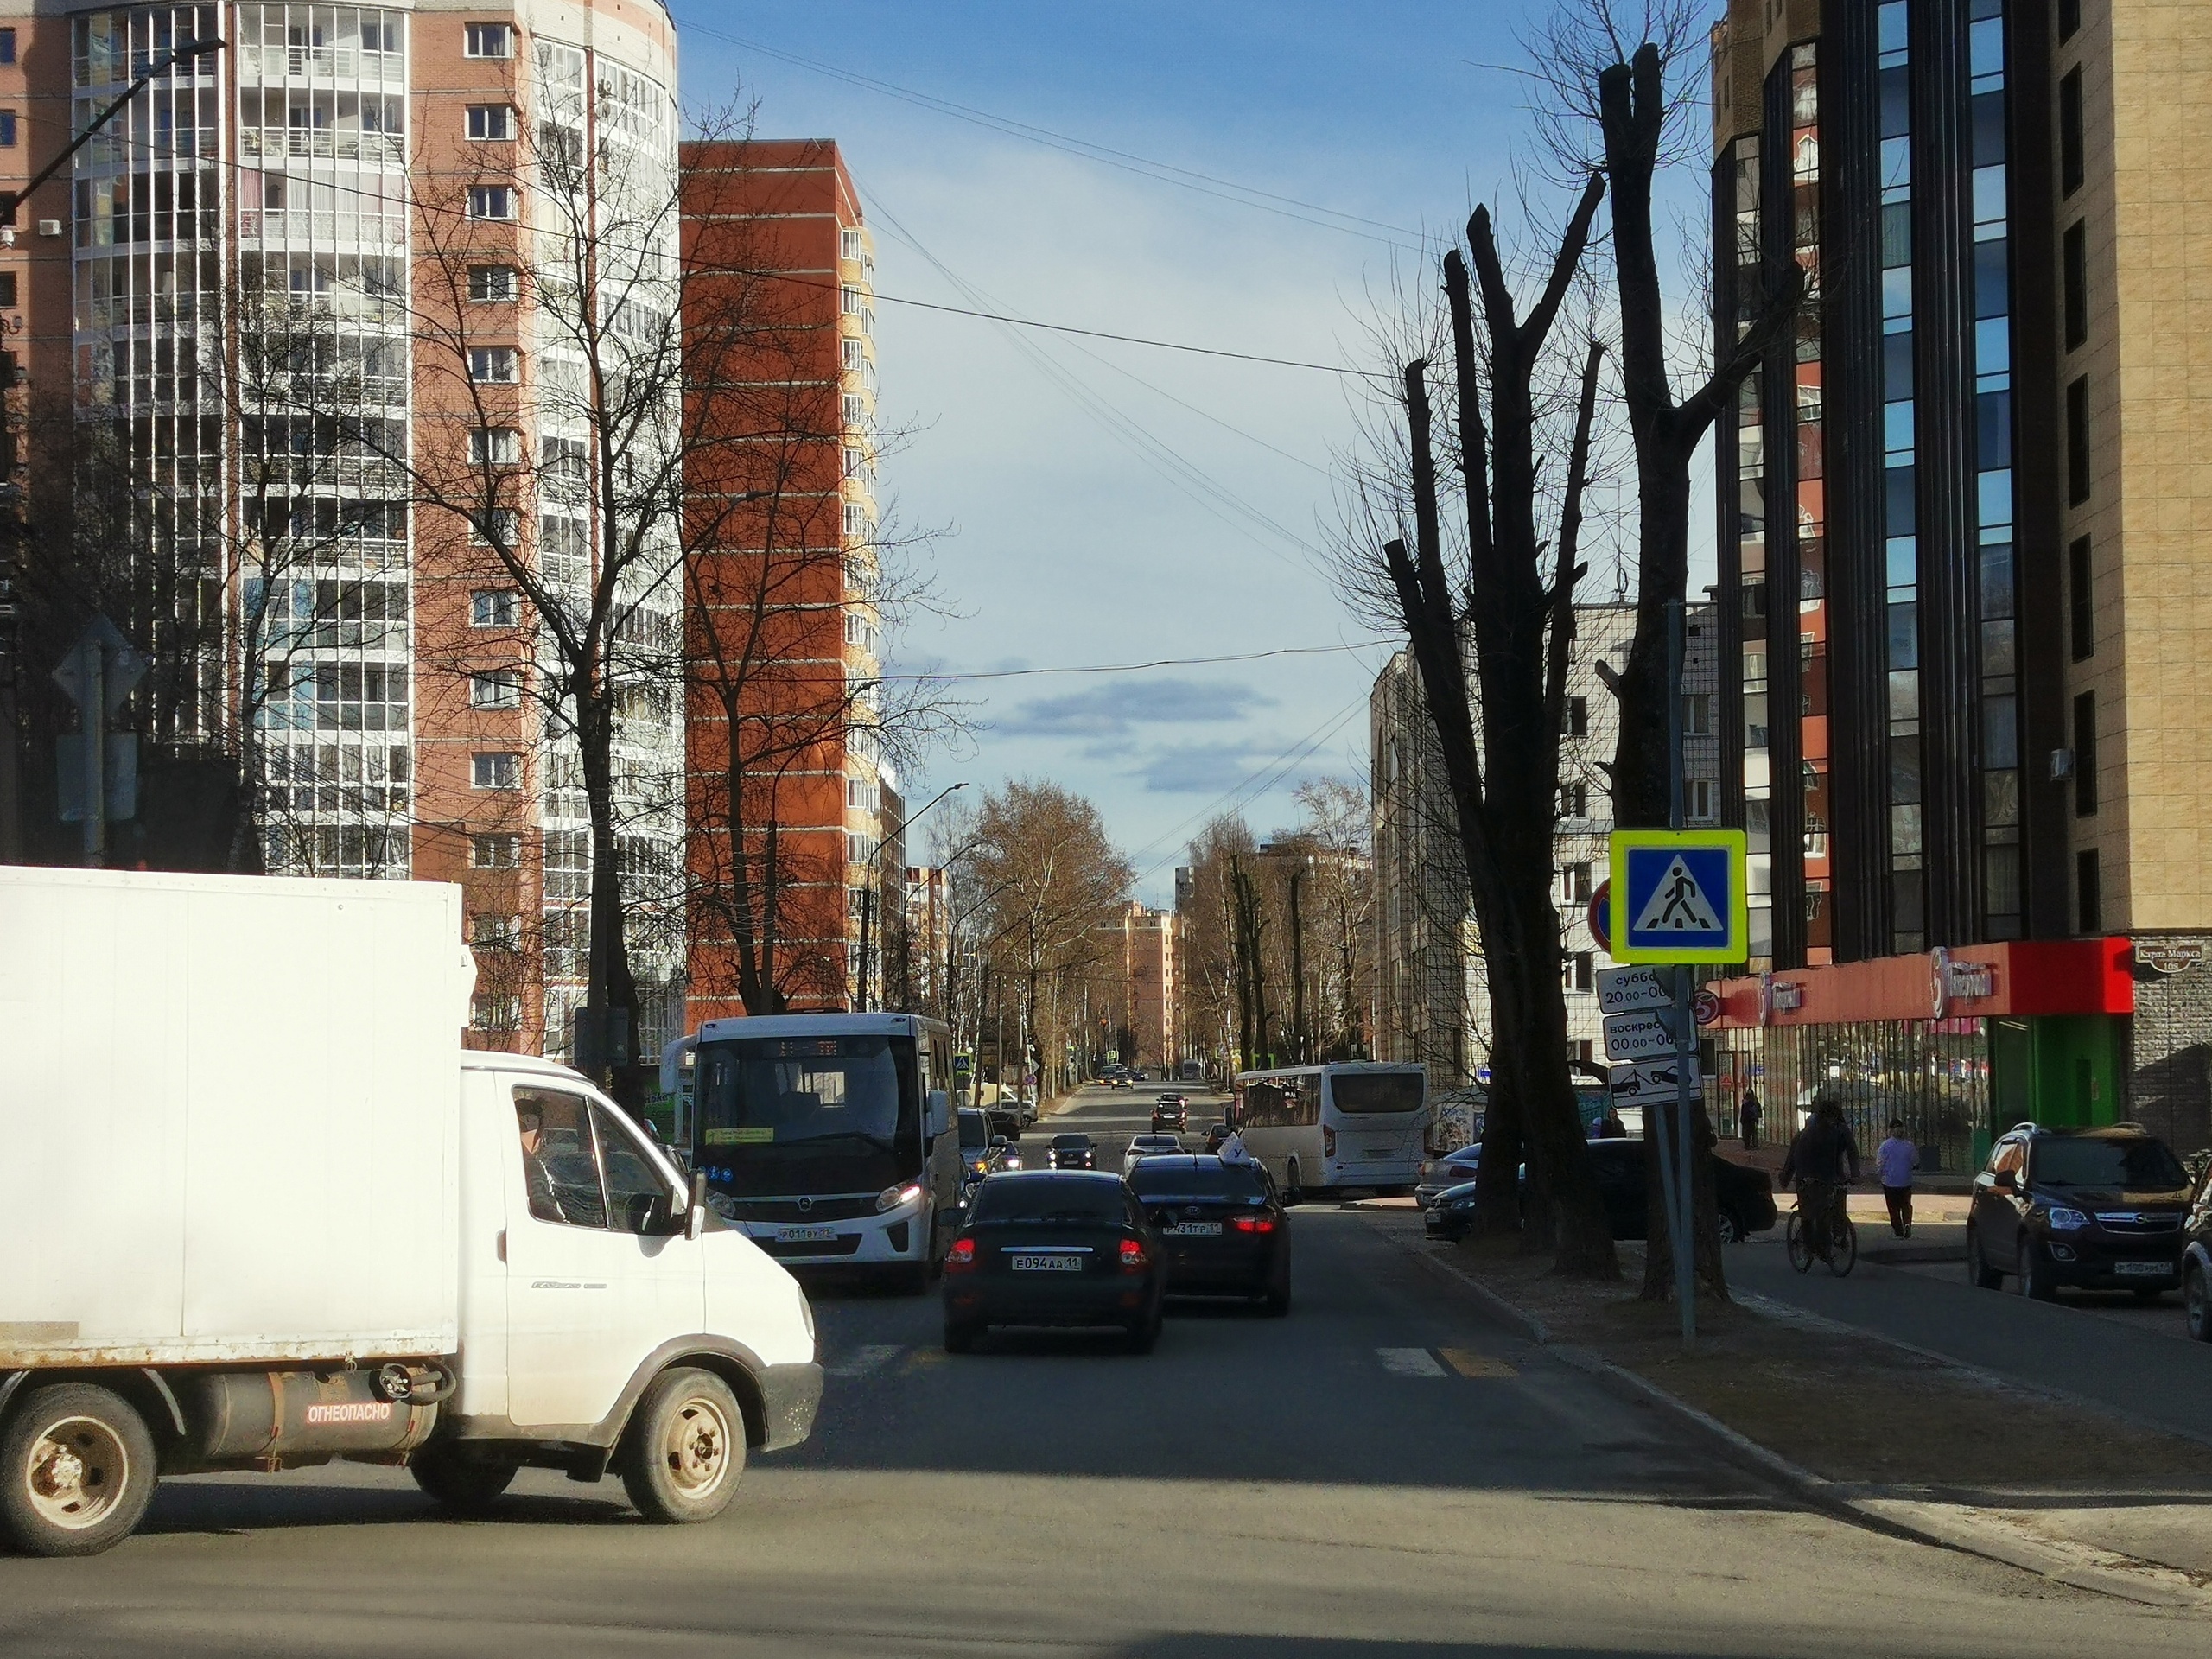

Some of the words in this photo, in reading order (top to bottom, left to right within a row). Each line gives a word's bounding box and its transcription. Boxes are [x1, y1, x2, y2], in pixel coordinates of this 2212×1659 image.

[1616, 972, 1655, 987] суббо
[1610, 1021, 1660, 1034] воскрес
[308, 1402, 391, 1422] ОГНЕОПАСНО
